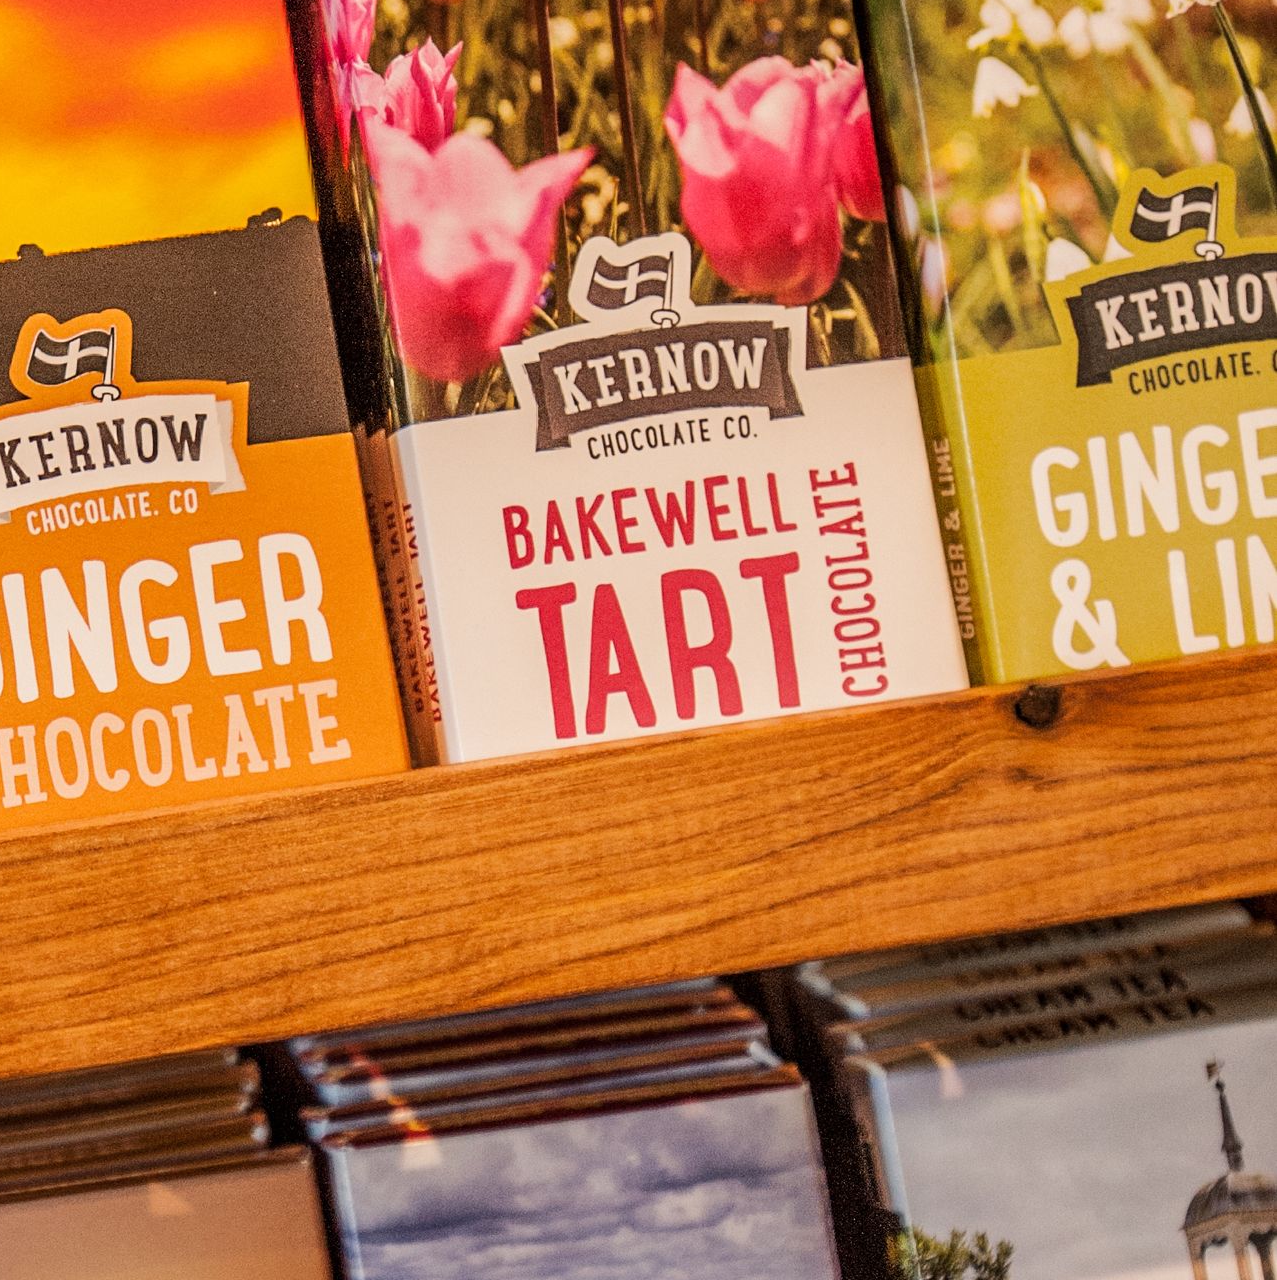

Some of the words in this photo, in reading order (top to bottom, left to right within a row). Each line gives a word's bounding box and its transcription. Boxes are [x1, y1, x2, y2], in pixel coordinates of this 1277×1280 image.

[1095, 269, 1277, 350] KERNO
[553, 336, 768, 416] KERNOW
[1129, 351, 1262, 396] CHOCOLATE.
[587, 419, 712, 460] CHOCOLATE
[723, 415, 759, 441] CO.
[931, 436, 961, 498] LIME
[1031, 407, 1277, 548] GINGE
[25, 492, 159, 536] CHOCOLATE.
[168, 487, 199, 515] CO
[402, 502, 420, 560] TART
[502, 473, 798, 570] BAKEWELL
[944, 507, 963, 535] &
[808, 461, 889, 699] CHOCOLATE
[947, 542, 975, 640] GINGER
[1050, 559, 1130, 670] &
[414, 575, 443, 724] BAKEWELL
[515, 551, 802, 740] TART
